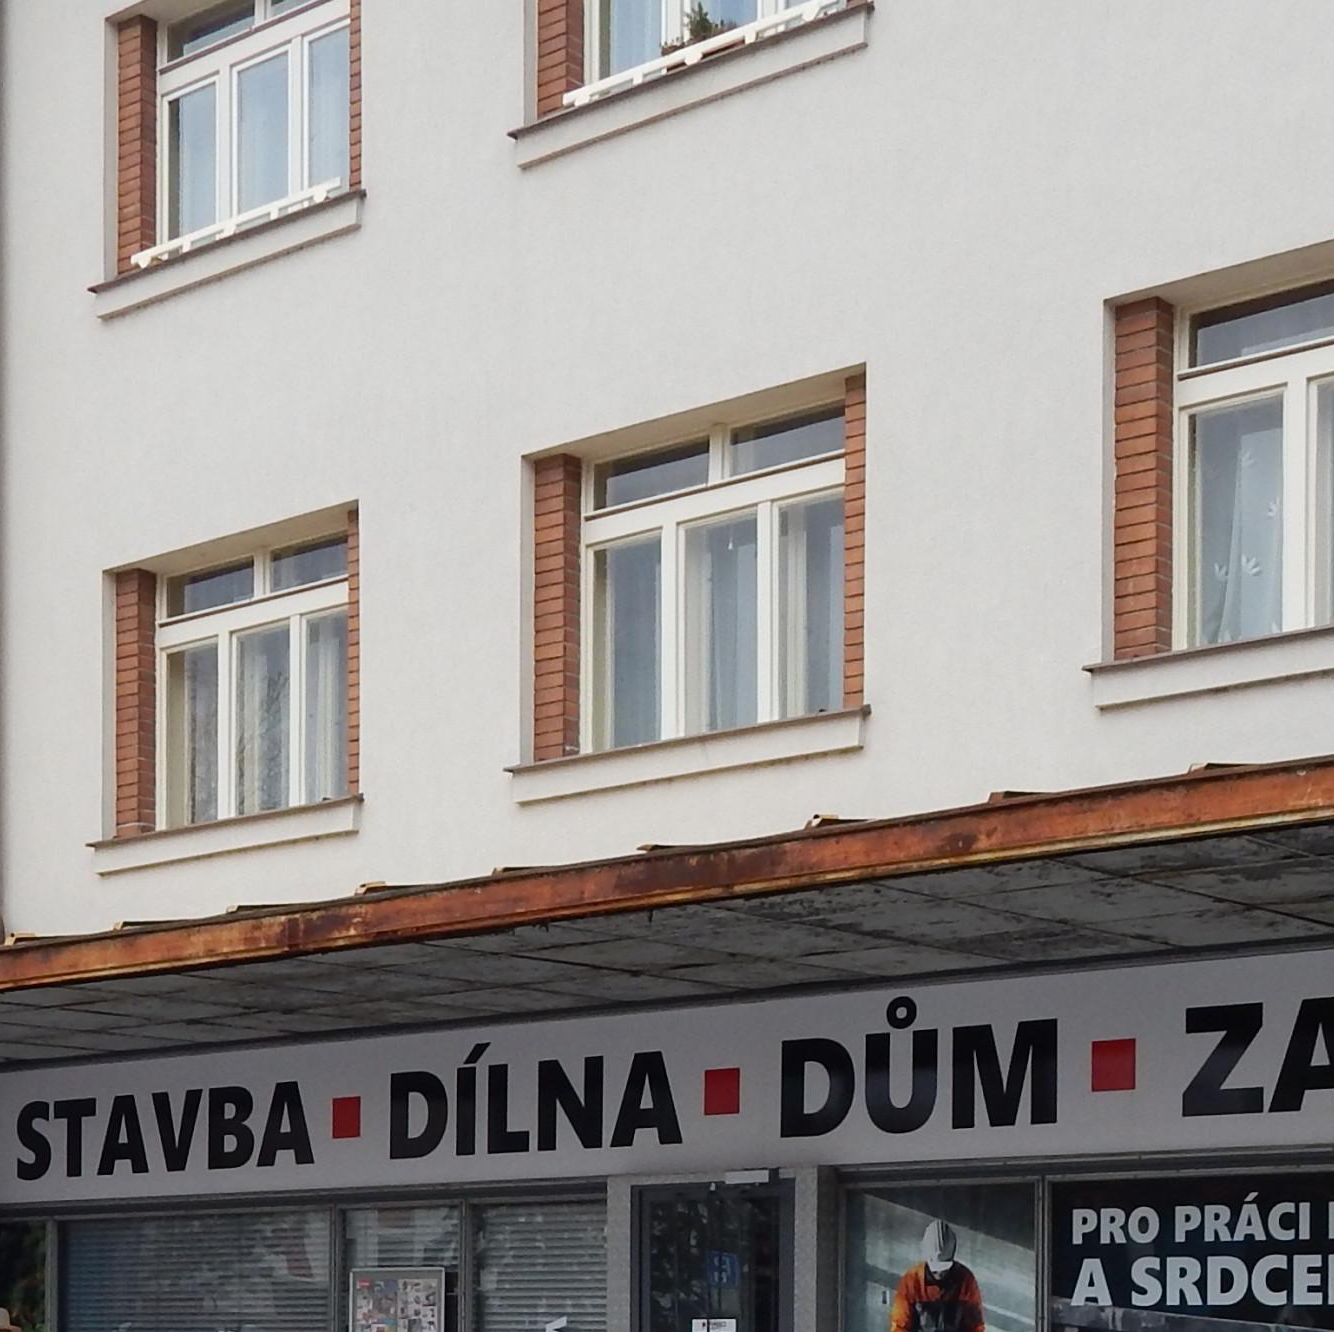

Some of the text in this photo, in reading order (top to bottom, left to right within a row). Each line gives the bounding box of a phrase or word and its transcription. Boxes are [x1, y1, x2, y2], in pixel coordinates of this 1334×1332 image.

[17, 1081, 314, 1181] STAVBA
[390, 1042, 683, 1159] DÍLNA
[781, 996, 1057, 1138] DŮM
[1072, 1206, 1159, 1245] PRO
[1174, 1192, 1311, 1243] PRÁCI
[1070, 1258, 1113, 1307] A
